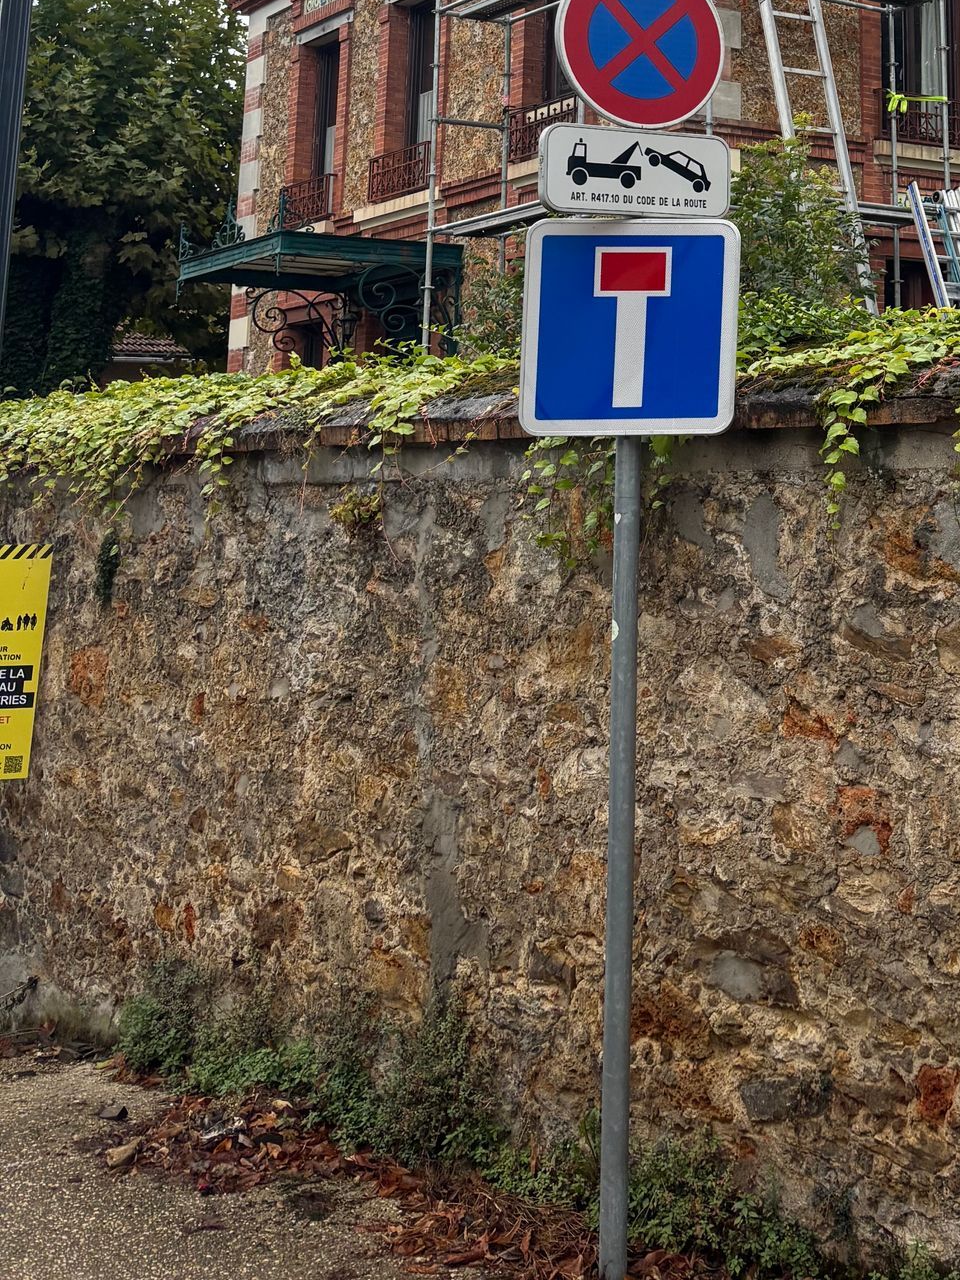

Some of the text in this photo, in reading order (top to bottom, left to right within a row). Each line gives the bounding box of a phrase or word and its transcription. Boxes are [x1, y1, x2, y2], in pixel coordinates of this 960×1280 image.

[570, 192, 707, 208] ART. R417.10 DU CODE DE LA ROUTE
[9, 668, 25, 679] LA
[0, 694, 27, 706] RIES
